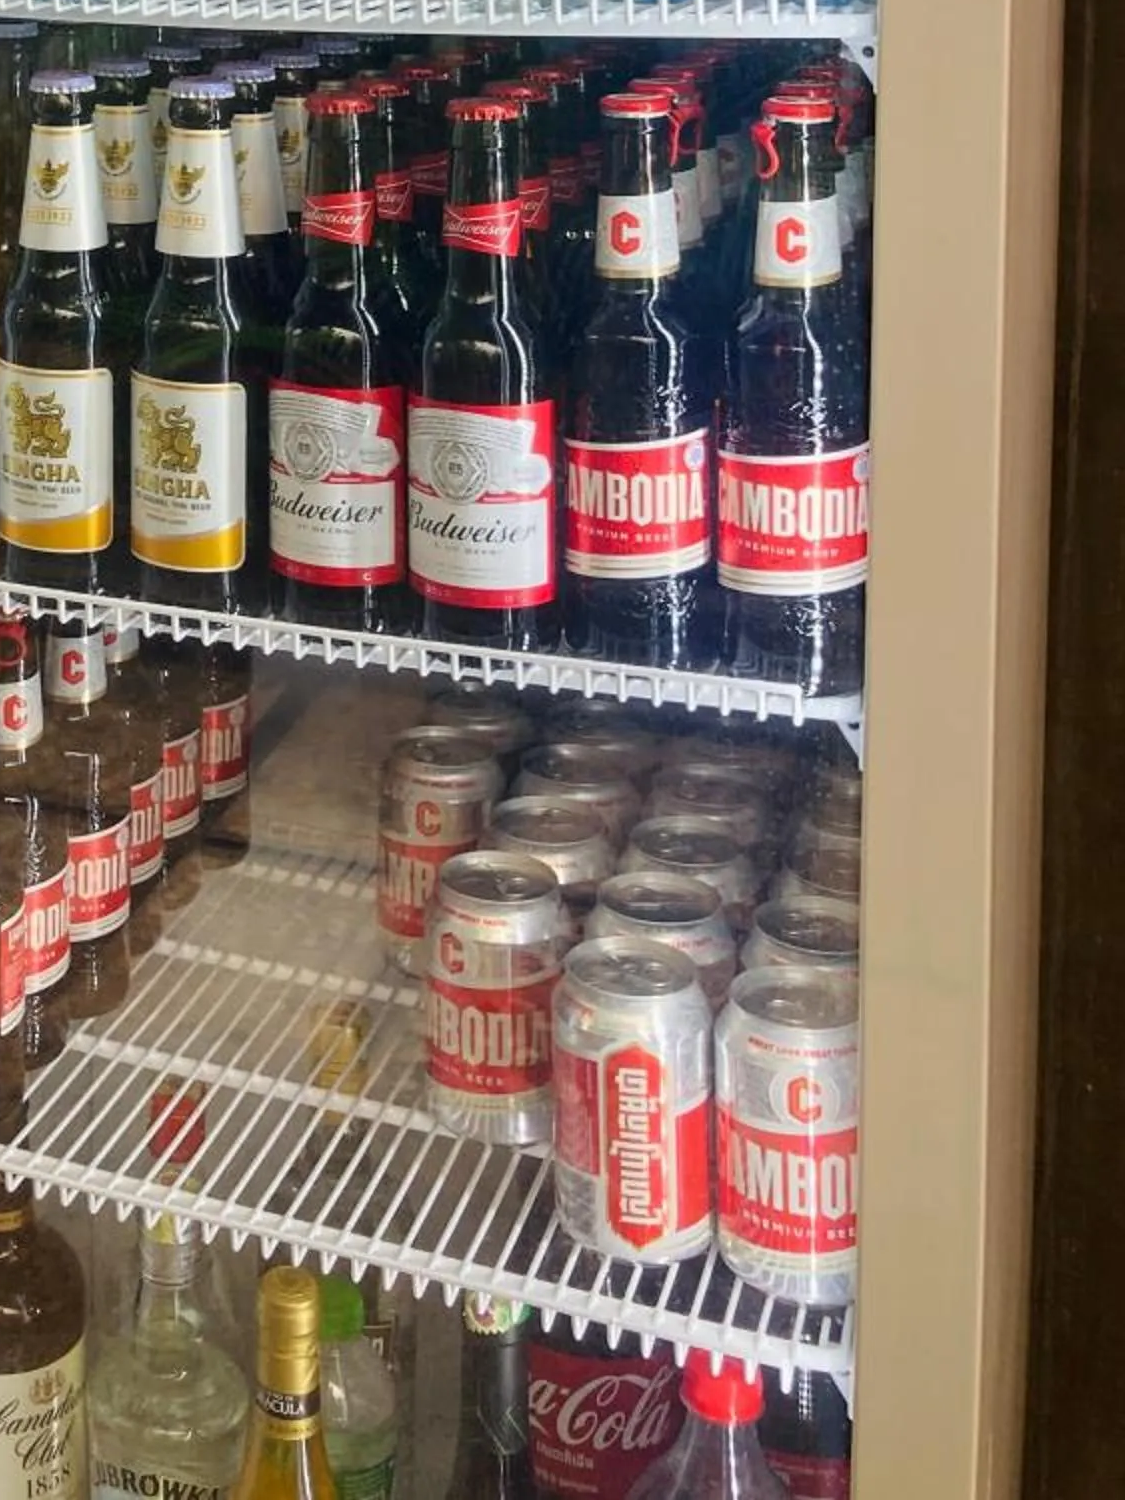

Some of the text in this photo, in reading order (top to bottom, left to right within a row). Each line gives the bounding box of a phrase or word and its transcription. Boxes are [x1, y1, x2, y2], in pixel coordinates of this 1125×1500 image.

[610, 211, 641, 256] C
[775, 217, 807, 263] C
[567, 467, 705, 527] AMBODIA
[61, 649, 86, 686] C
[1, 694, 29, 732] C
[414, 800, 442, 837] C
[439, 931, 465, 974] C
[787, 1075, 822, 1124] C
[826, 1227, 857, 1240] BEE
[528, 1365, 675, 1451] a-Cola
[94, 1459, 225, 1500] UBROWK
